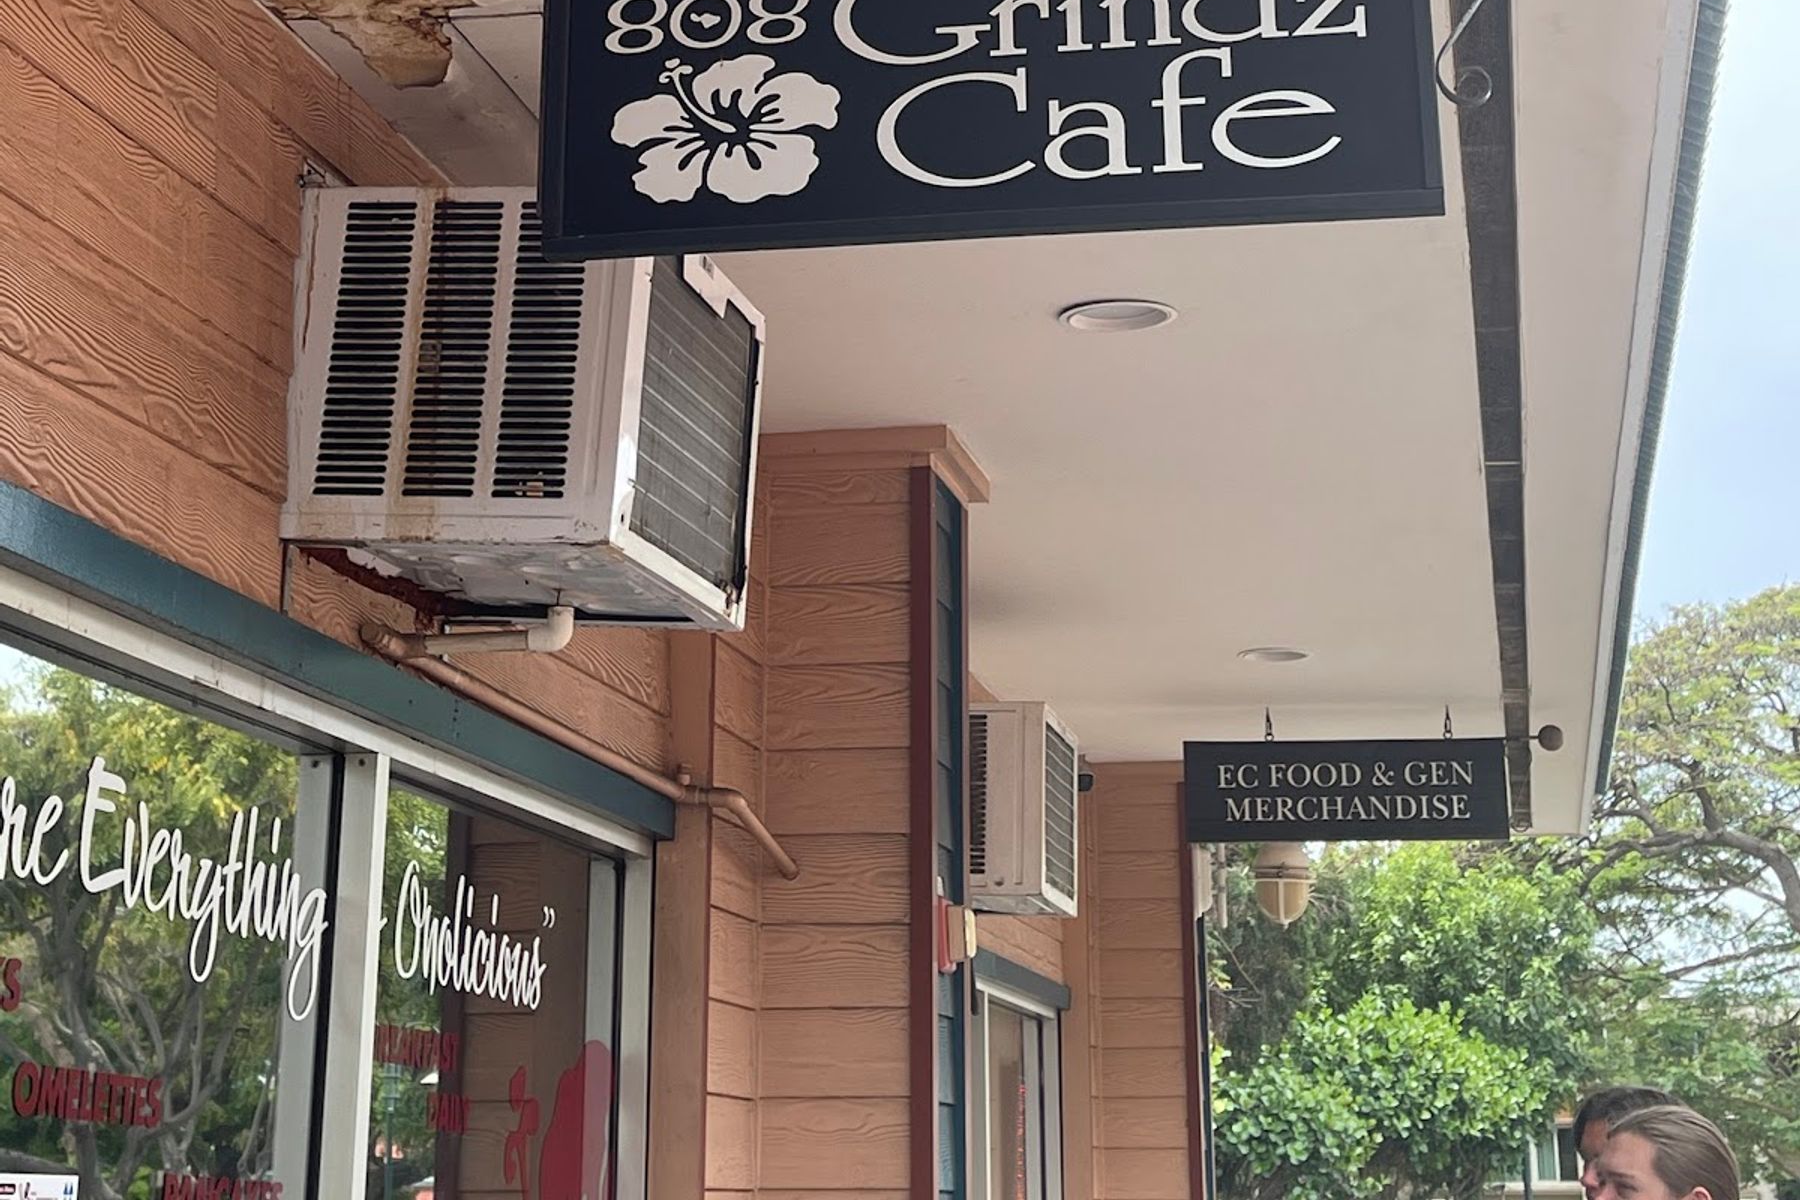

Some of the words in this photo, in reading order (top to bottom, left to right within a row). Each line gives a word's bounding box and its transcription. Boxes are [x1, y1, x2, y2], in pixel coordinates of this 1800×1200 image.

[876, 47, 1343, 188] Cafe
[1217, 764, 1259, 789] EC
[1268, 762, 1362, 788] FOOD
[1371, 761, 1395, 787] &
[1403, 760, 1474, 787] GEN
[1224, 794, 1472, 822] MERCHANDISE
[80, 755, 329, 1021] Everything
[12, 1061, 165, 1130] OMELETTES
